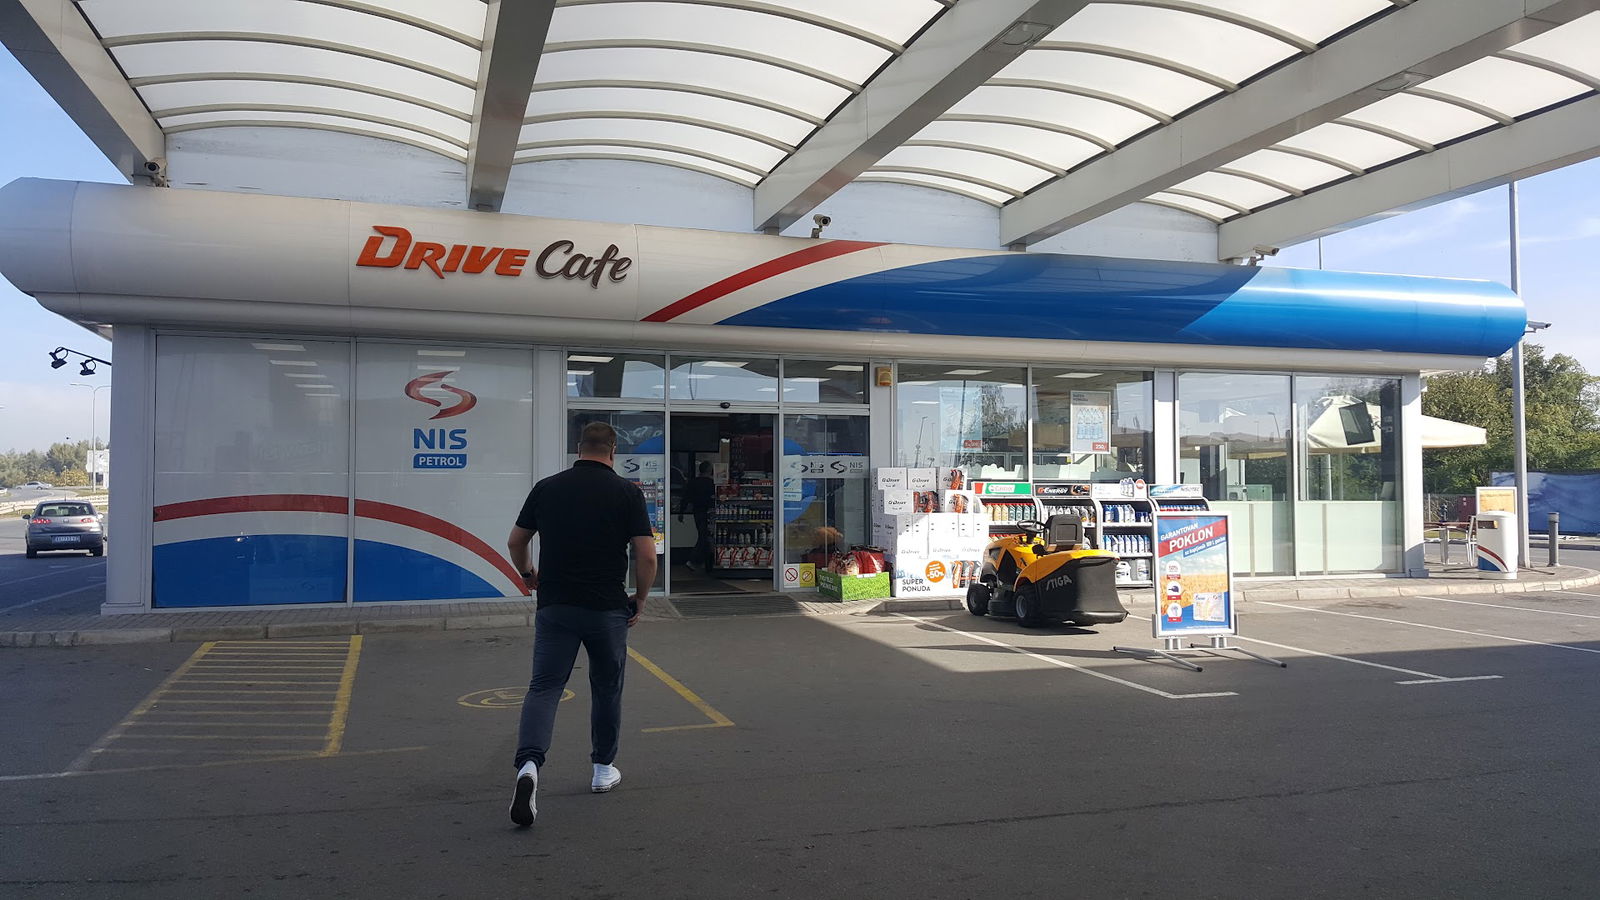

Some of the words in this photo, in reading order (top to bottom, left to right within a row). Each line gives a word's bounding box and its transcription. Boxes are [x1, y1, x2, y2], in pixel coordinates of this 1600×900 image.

[356, 225, 531, 279] DRIVE
[535, 240, 633, 290] Cafe
[413, 427, 468, 450] NIS
[418, 456, 463, 466] PETROL
[849, 461, 864, 469] NIS
[1160, 521, 1199, 541] GARANTOVAN
[1169, 526, 1214, 552] POKLON
[902, 578, 924, 586] SUPER
[902, 585, 931, 593] PONUDA
[1046, 574, 1072, 591] STIGA
